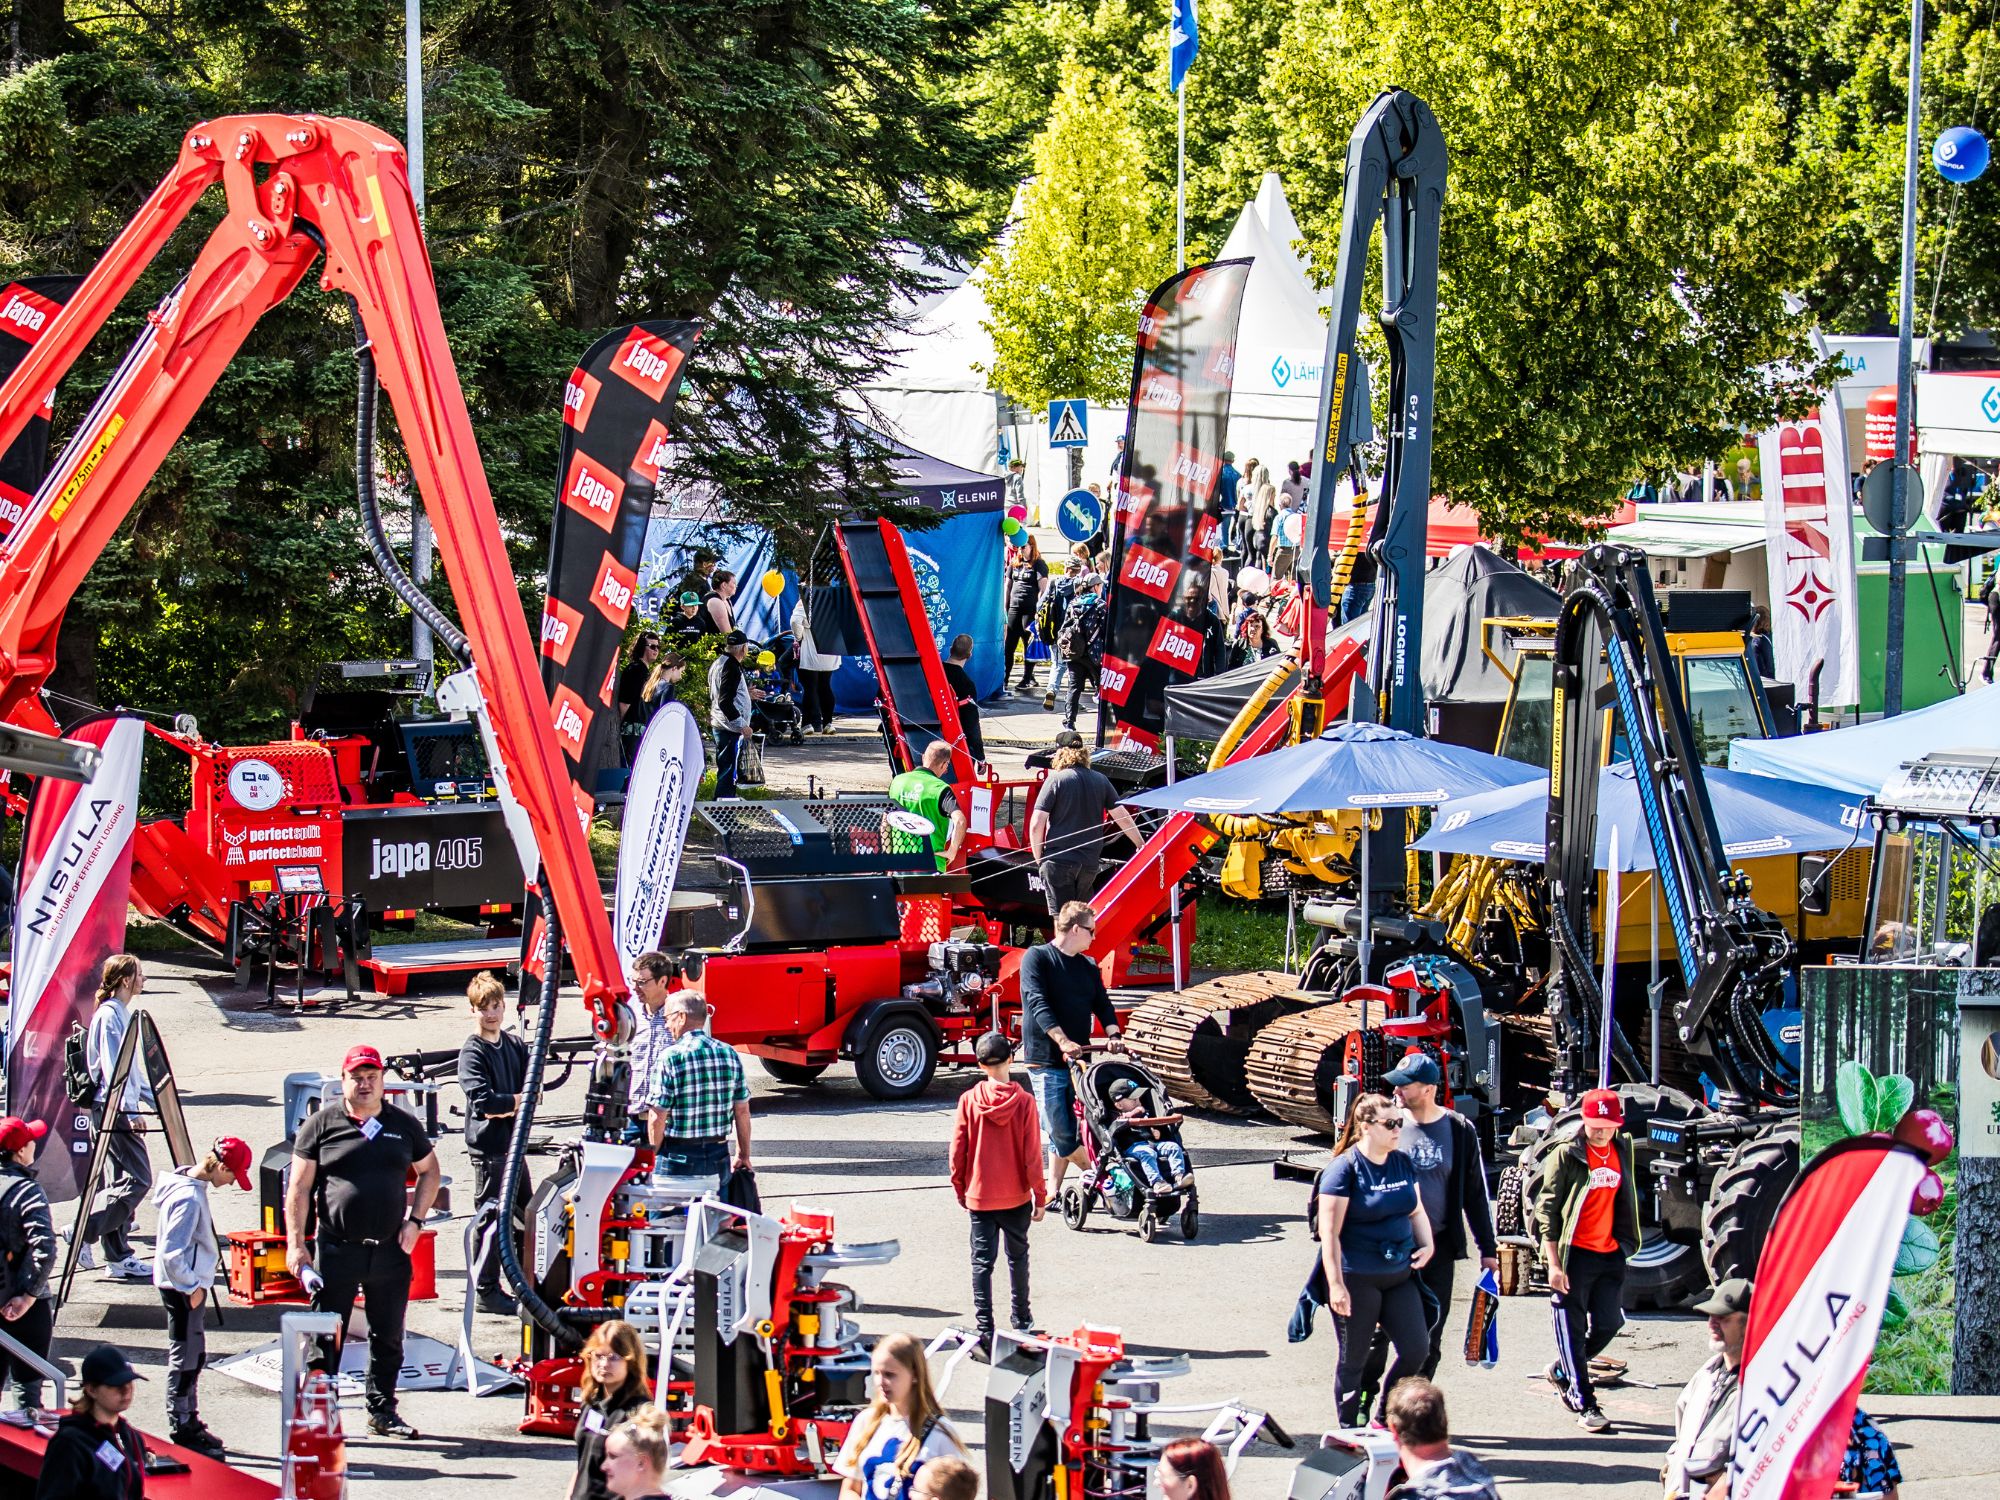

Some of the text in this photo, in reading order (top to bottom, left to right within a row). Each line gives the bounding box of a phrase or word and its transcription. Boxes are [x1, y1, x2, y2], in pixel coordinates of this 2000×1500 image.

[1, 295, 46, 331] japa
[1139, 314, 1155, 334] pa
[623, 340, 668, 383] japa
[1212, 352, 1234, 380] jap
[565, 382, 585, 412] pa
[1143, 378, 1183, 411] japa
[1328, 356, 1347, 460] VAARA-ALUE 90m
[1408, 395, 1419, 440] 6-7 M
[644, 437, 664, 467] ja
[1172, 453, 1211, 485] japa
[72, 462, 95, 489] 75m
[572, 467, 615, 513] japa
[0, 498, 23, 524] pa
[958, 491, 998, 503] ELENIA
[1118, 492, 1140, 514] pa
[1200, 526, 1217, 549] ja
[1128, 556, 1168, 588] japa
[599, 568, 631, 611] japa
[542, 612, 568, 646] pa
[1157, 629, 1196, 661] japa
[1395, 615, 1407, 687] LOGMER
[1100, 667, 1126, 692] apa
[554, 700, 582, 742] japa
[1556, 702, 1561, 714] 70
[648, 772, 677, 879] Harvesters
[27, 800, 112, 936] NISULA
[55, 893, 74, 925] FUTURE
[72, 880, 81, 893] OF
[79, 842, 105, 880] EFFICIENT
[103, 803, 125, 841] LOGGING
[370, 837, 483, 880] japa 405
[656, 875, 670, 919] VUOTTA
[1597, 1101, 1608, 1115] LA
[1651, 1128, 1679, 1143] VIMEK
[723, 1276, 731, 1334] NISULA
[1731, 1291, 1851, 1475] ISULA
[1013, 1401, 1022, 1462] NISULA
[1740, 1451, 1773, 1500] UTURE
